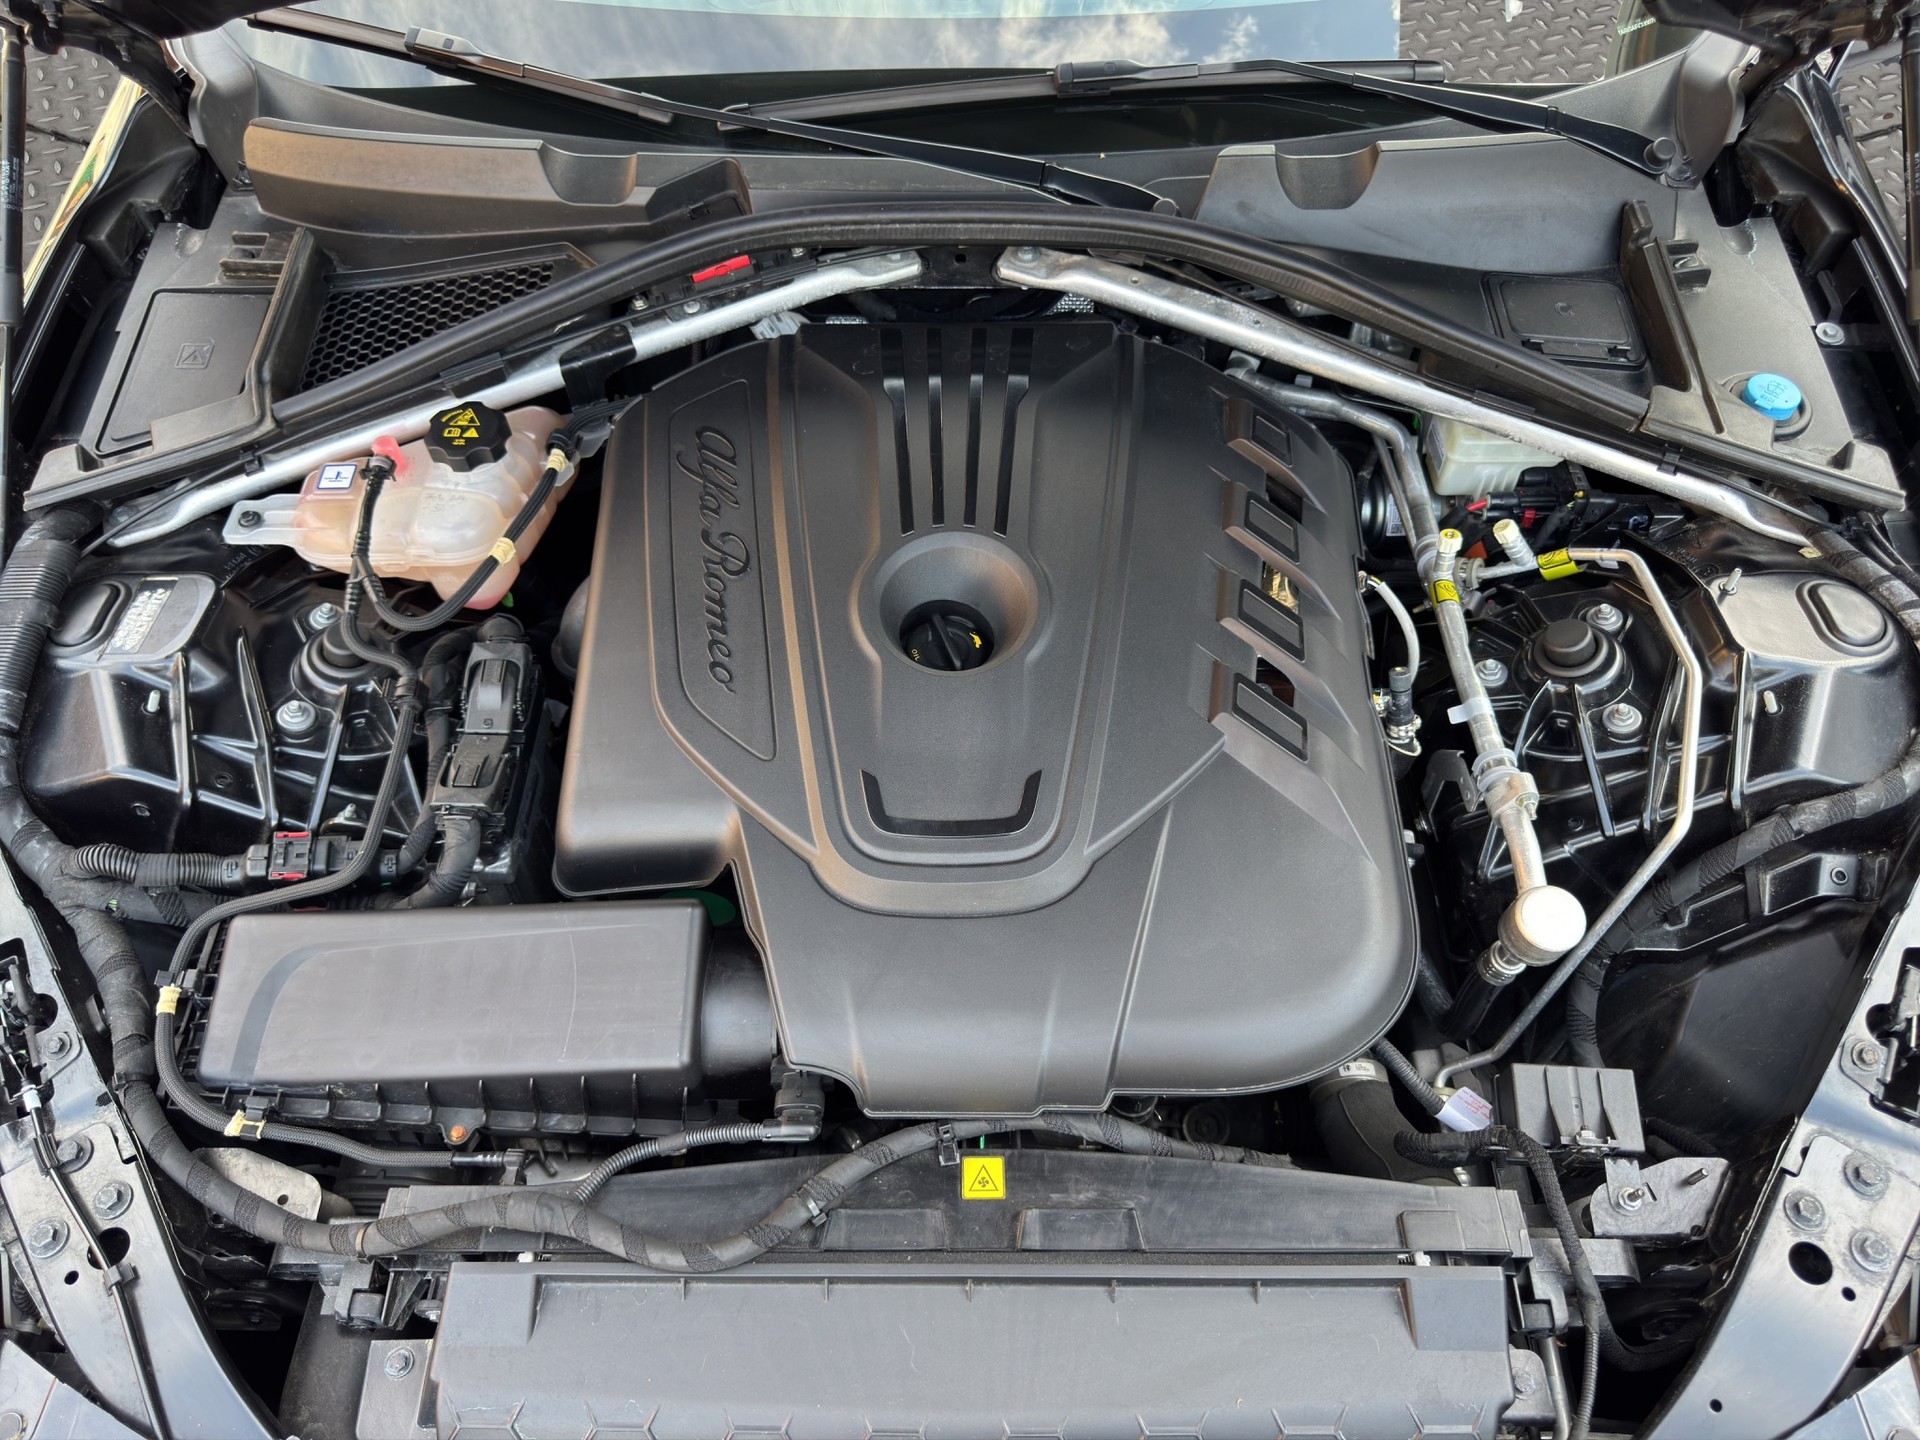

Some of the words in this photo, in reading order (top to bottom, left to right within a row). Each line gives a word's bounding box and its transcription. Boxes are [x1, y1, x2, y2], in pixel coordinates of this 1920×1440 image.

[676, 425, 739, 527] Alfa
[701, 527, 751, 694] Romeo
[911, 648, 921, 662] OIL
